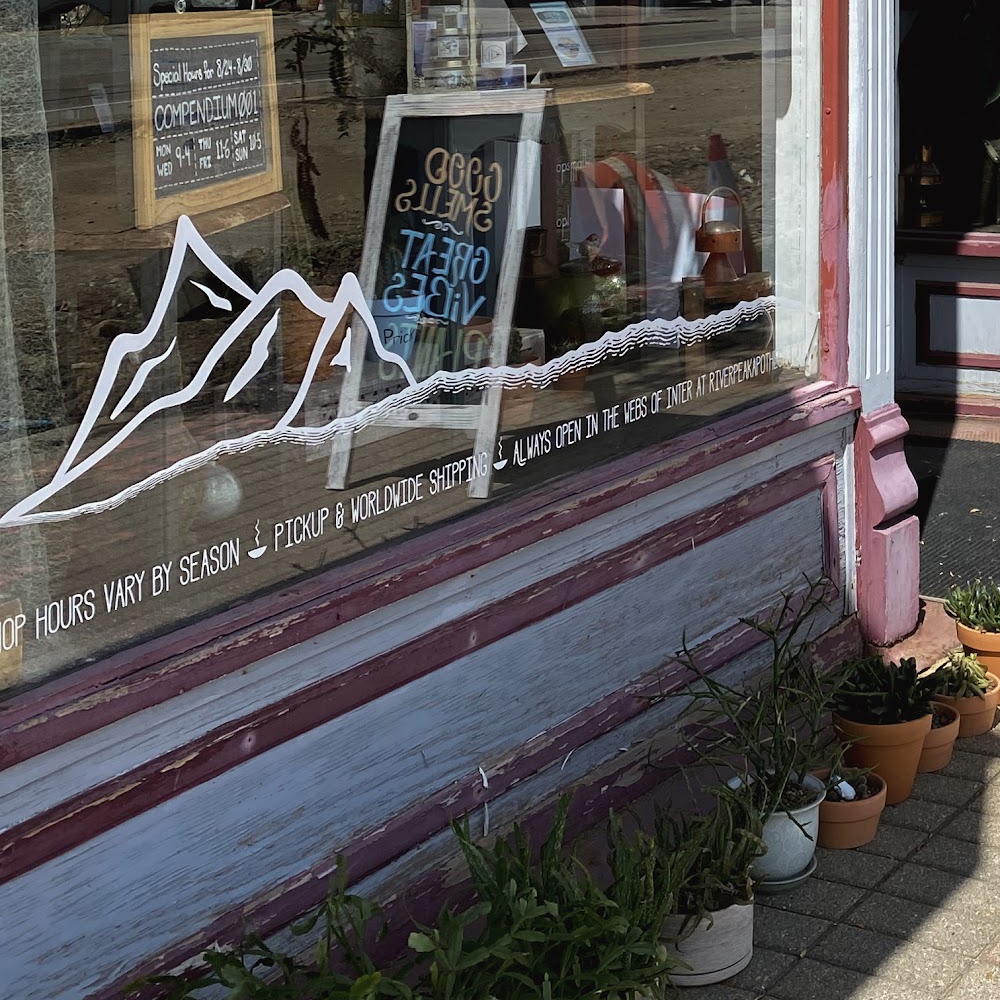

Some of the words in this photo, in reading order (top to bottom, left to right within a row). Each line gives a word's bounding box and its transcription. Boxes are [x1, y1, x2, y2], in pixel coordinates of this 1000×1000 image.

[153, 62, 183, 92] Special
[183, 63, 203, 83] Hours
[203, 60, 214, 82] for
[198, 137, 212, 151] THU
[233, 130, 247, 146] SAT
[155, 143, 172, 158] MON
[235, 145, 249, 163] SUN
[157, 162, 173, 177] WED
[199, 156, 212, 170] FRI
[35, 589, 96, 640] HOURS
[104, 570, 146, 613] VARY
[152, 561, 173, 596] BY
[179, 537, 240, 586] SEASON
[273, 507, 330, 552] PICKUP
[335, 502, 345, 529] &
[351, 472, 424, 524] WORLDWIDE
[429, 451, 489, 496] SHIPPING
[513, 430, 552, 467] ALWAYS
[555, 416, 581, 448] OPEN
[585, 411, 599, 439] IN
[602, 404, 620, 432] THE
[623, 396, 648, 426] WEBS
[651, 389, 663, 415] OF
[666, 377, 693, 409] INTER
[695, 376, 707, 398] AT
